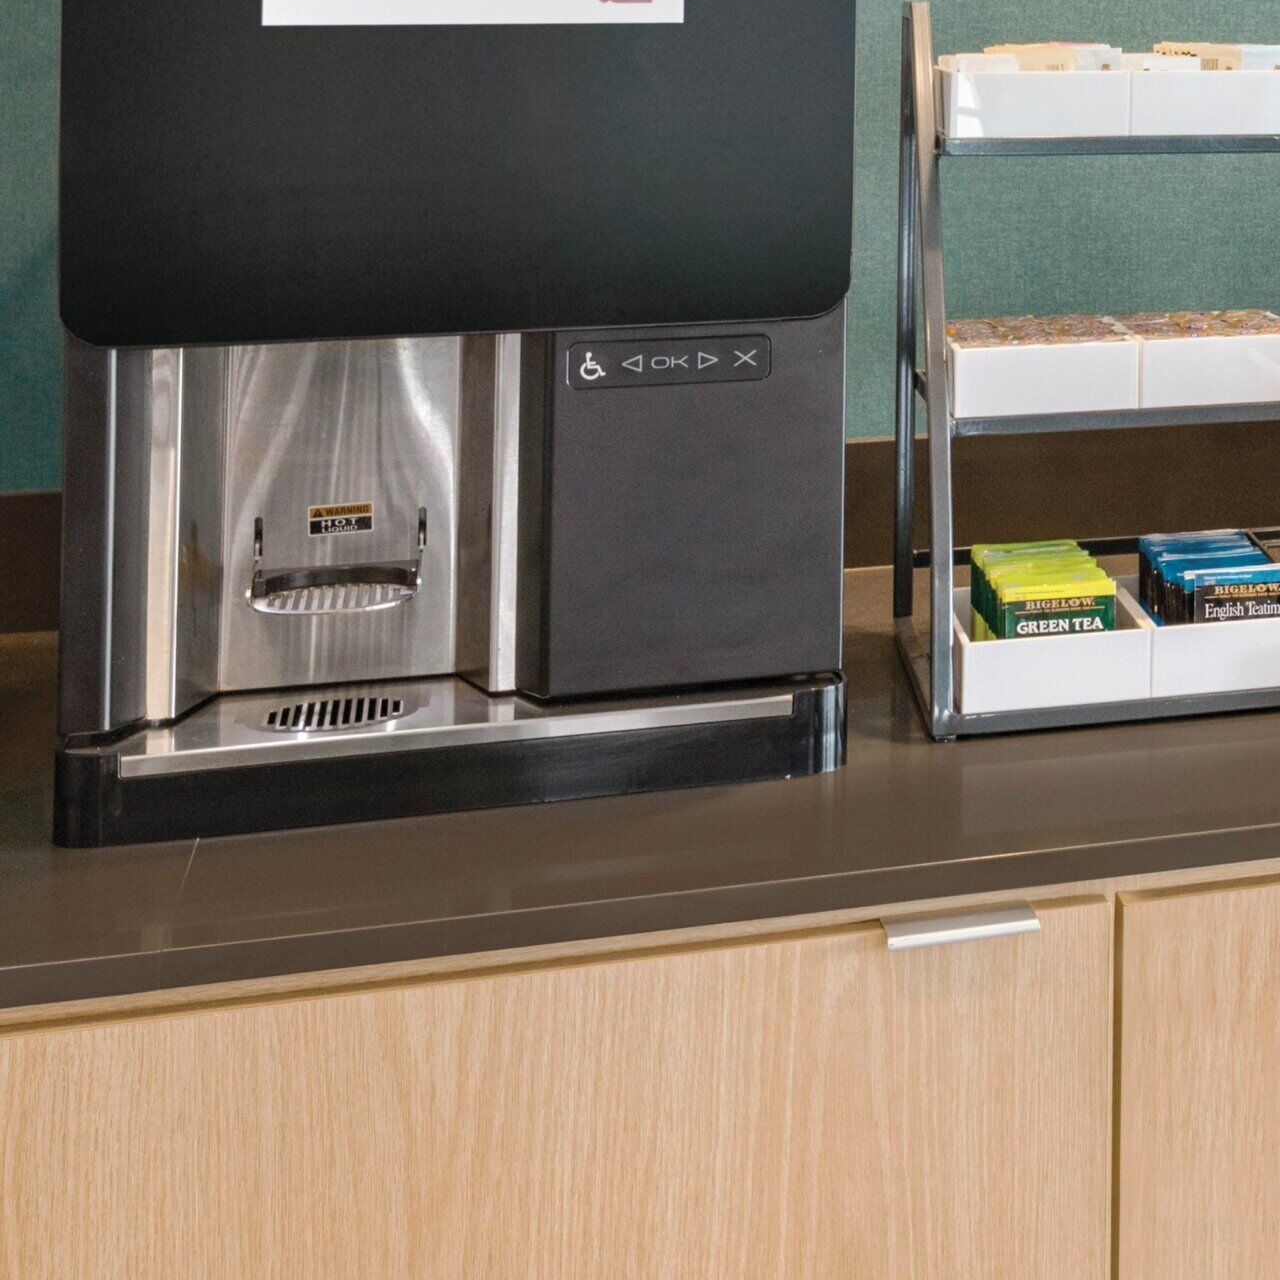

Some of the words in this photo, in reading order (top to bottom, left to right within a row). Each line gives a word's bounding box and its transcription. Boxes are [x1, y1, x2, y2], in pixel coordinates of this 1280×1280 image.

[651, 354, 690, 370] OK
[325, 503, 370, 516] WARNING
[321, 517, 358, 527] HOT
[321, 524, 358, 533] LIQUID
[1025, 596, 1095, 610] BIGELOW
[1204, 601, 1244, 621] English
[1016, 619, 1070, 634] GREEN
[1072, 616, 1104, 631] TEA
